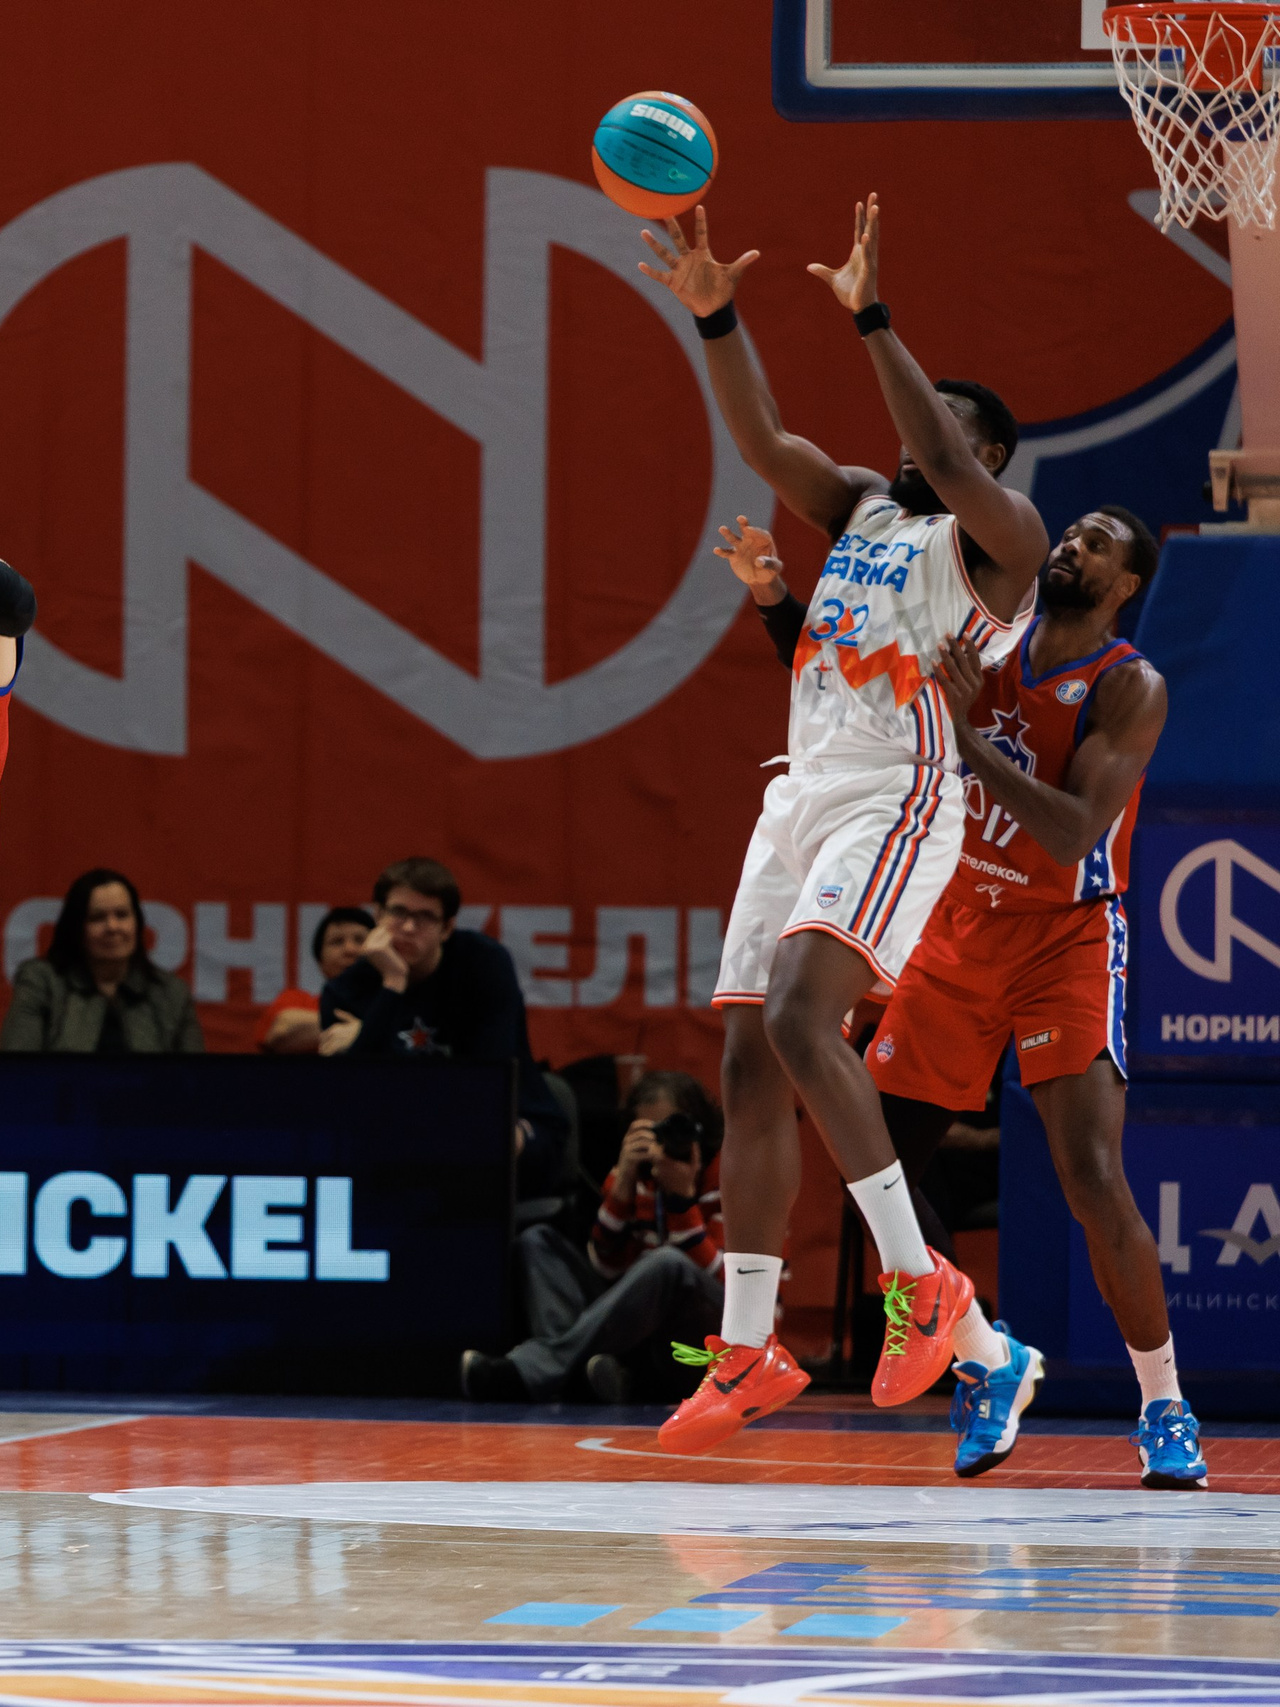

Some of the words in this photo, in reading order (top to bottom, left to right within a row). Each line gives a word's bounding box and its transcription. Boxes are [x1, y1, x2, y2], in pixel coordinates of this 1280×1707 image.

[810, 598, 869, 647] 32
[981, 803, 1020, 848] 17
[959, 852, 1030, 886] стелеком
[1161, 1014, 1280, 1042] НОРНИ
[1166, 1291, 1280, 1312] ИЦИНСК
